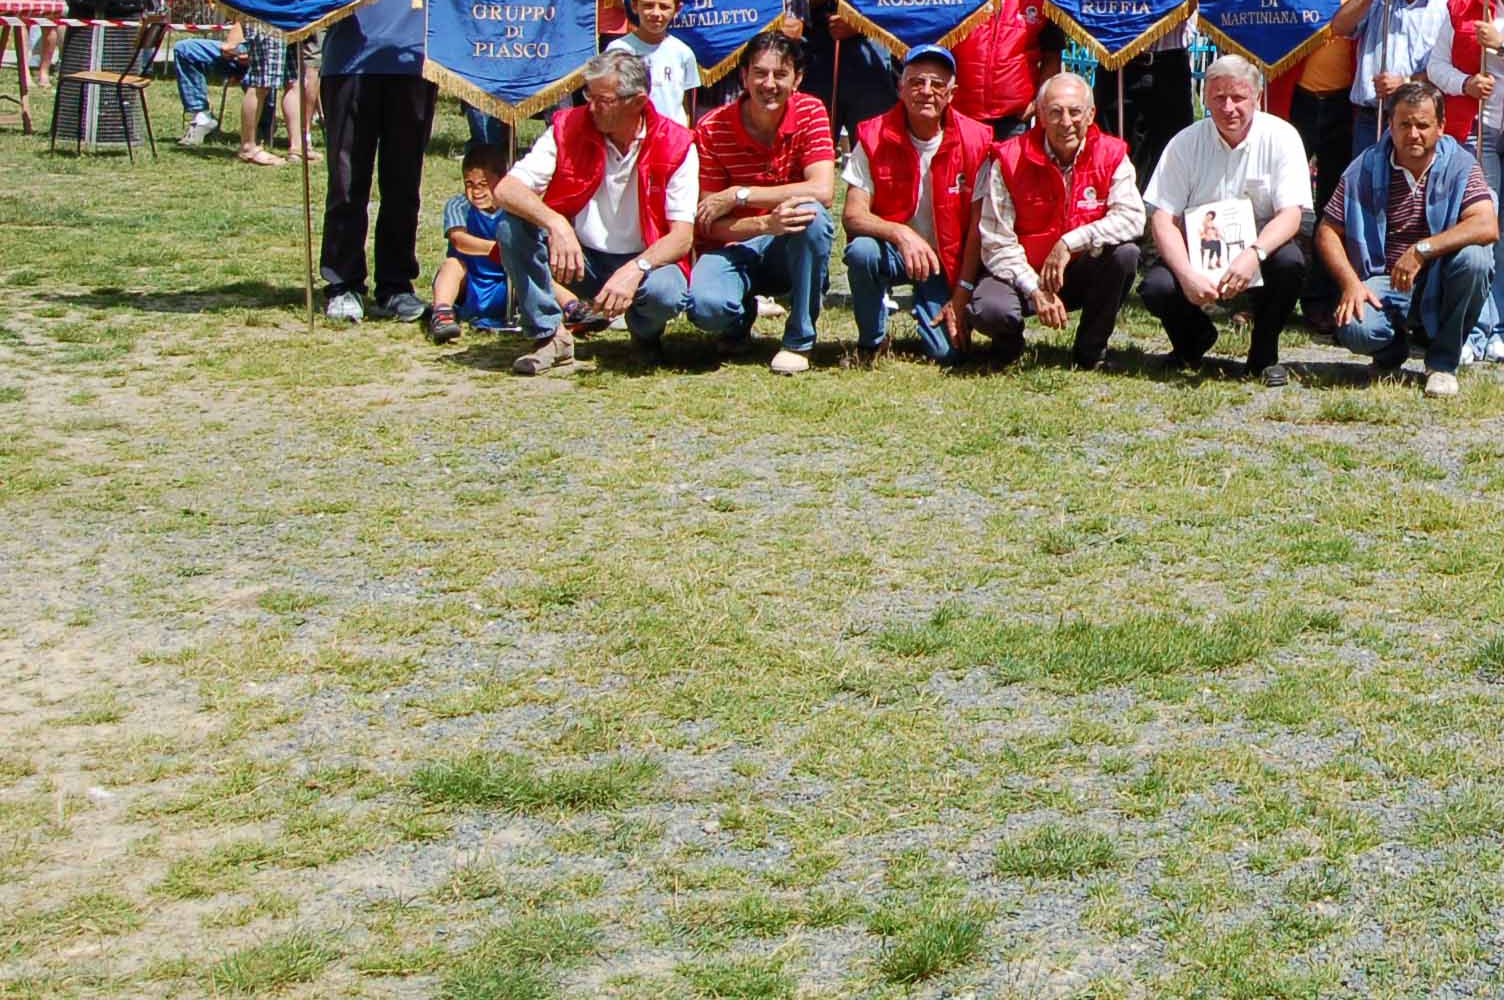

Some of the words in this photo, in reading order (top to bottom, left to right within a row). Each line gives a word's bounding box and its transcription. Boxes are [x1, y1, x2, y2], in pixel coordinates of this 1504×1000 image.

[471, 3, 556, 22] GRUPPO
[1080, 0, 1153, 16] RUFFIA
[1220, 10, 1300, 27] MARTINIANA
[1301, 8, 1321, 25] PO
[505, 24, 525, 39] DI
[472, 41, 550, 59] PIASCO
